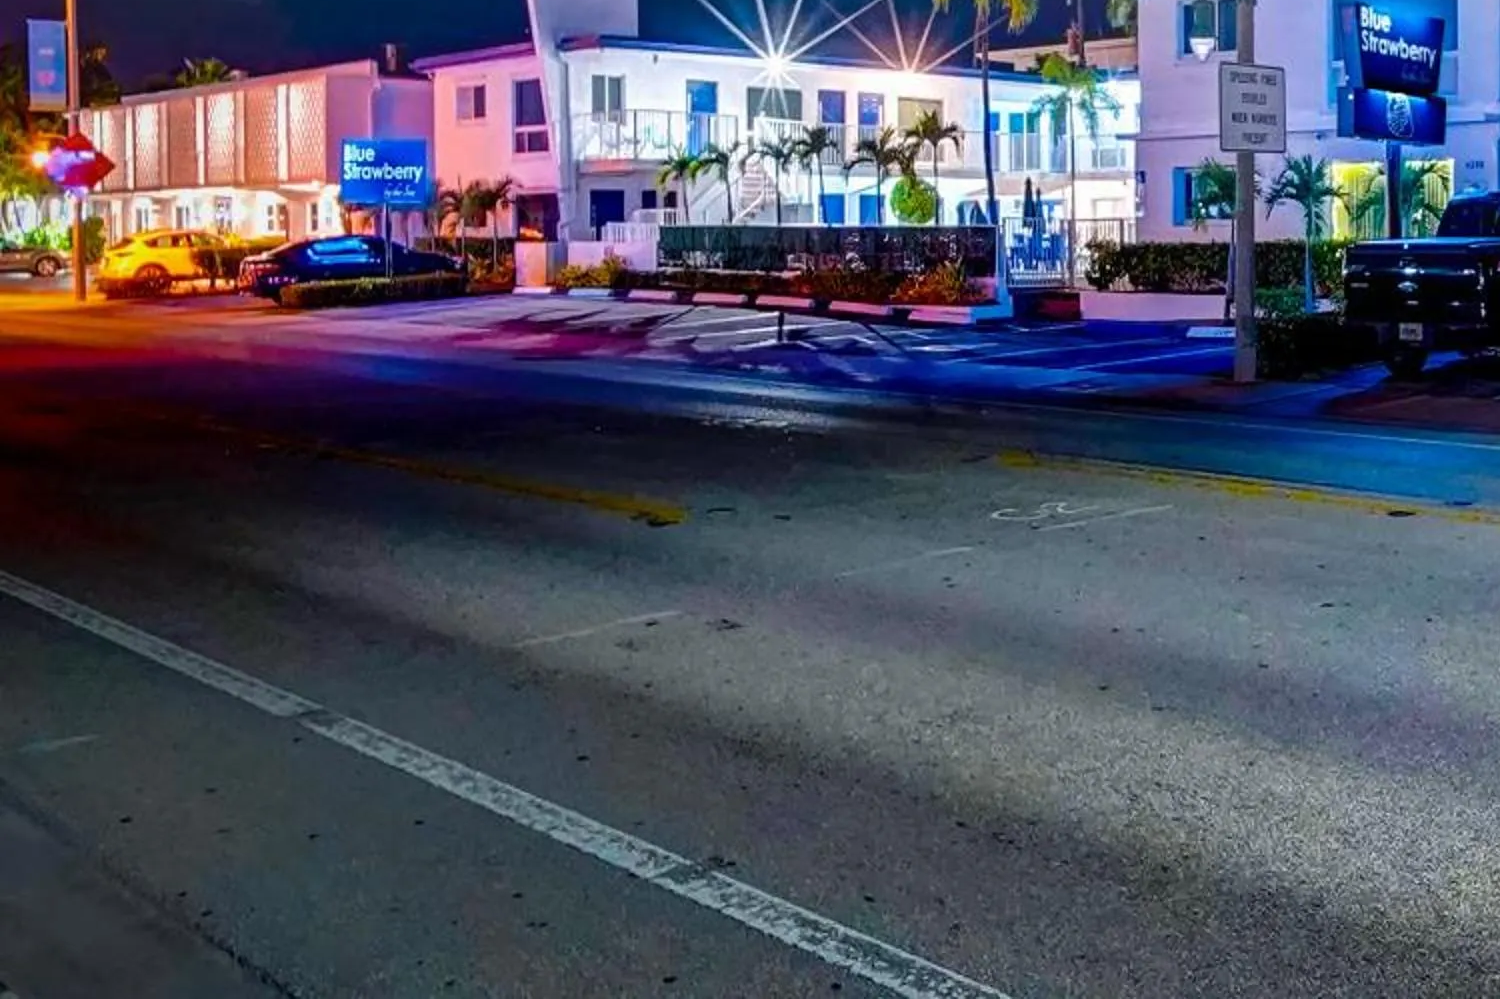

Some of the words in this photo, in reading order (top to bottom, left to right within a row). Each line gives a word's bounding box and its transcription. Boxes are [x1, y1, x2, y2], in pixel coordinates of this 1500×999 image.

[1361, 4, 1392, 33] Blue
[1361, 29, 1437, 69] Strawberry
[344, 144, 376, 162] Blue
[344, 162, 423, 184] Strawberry
